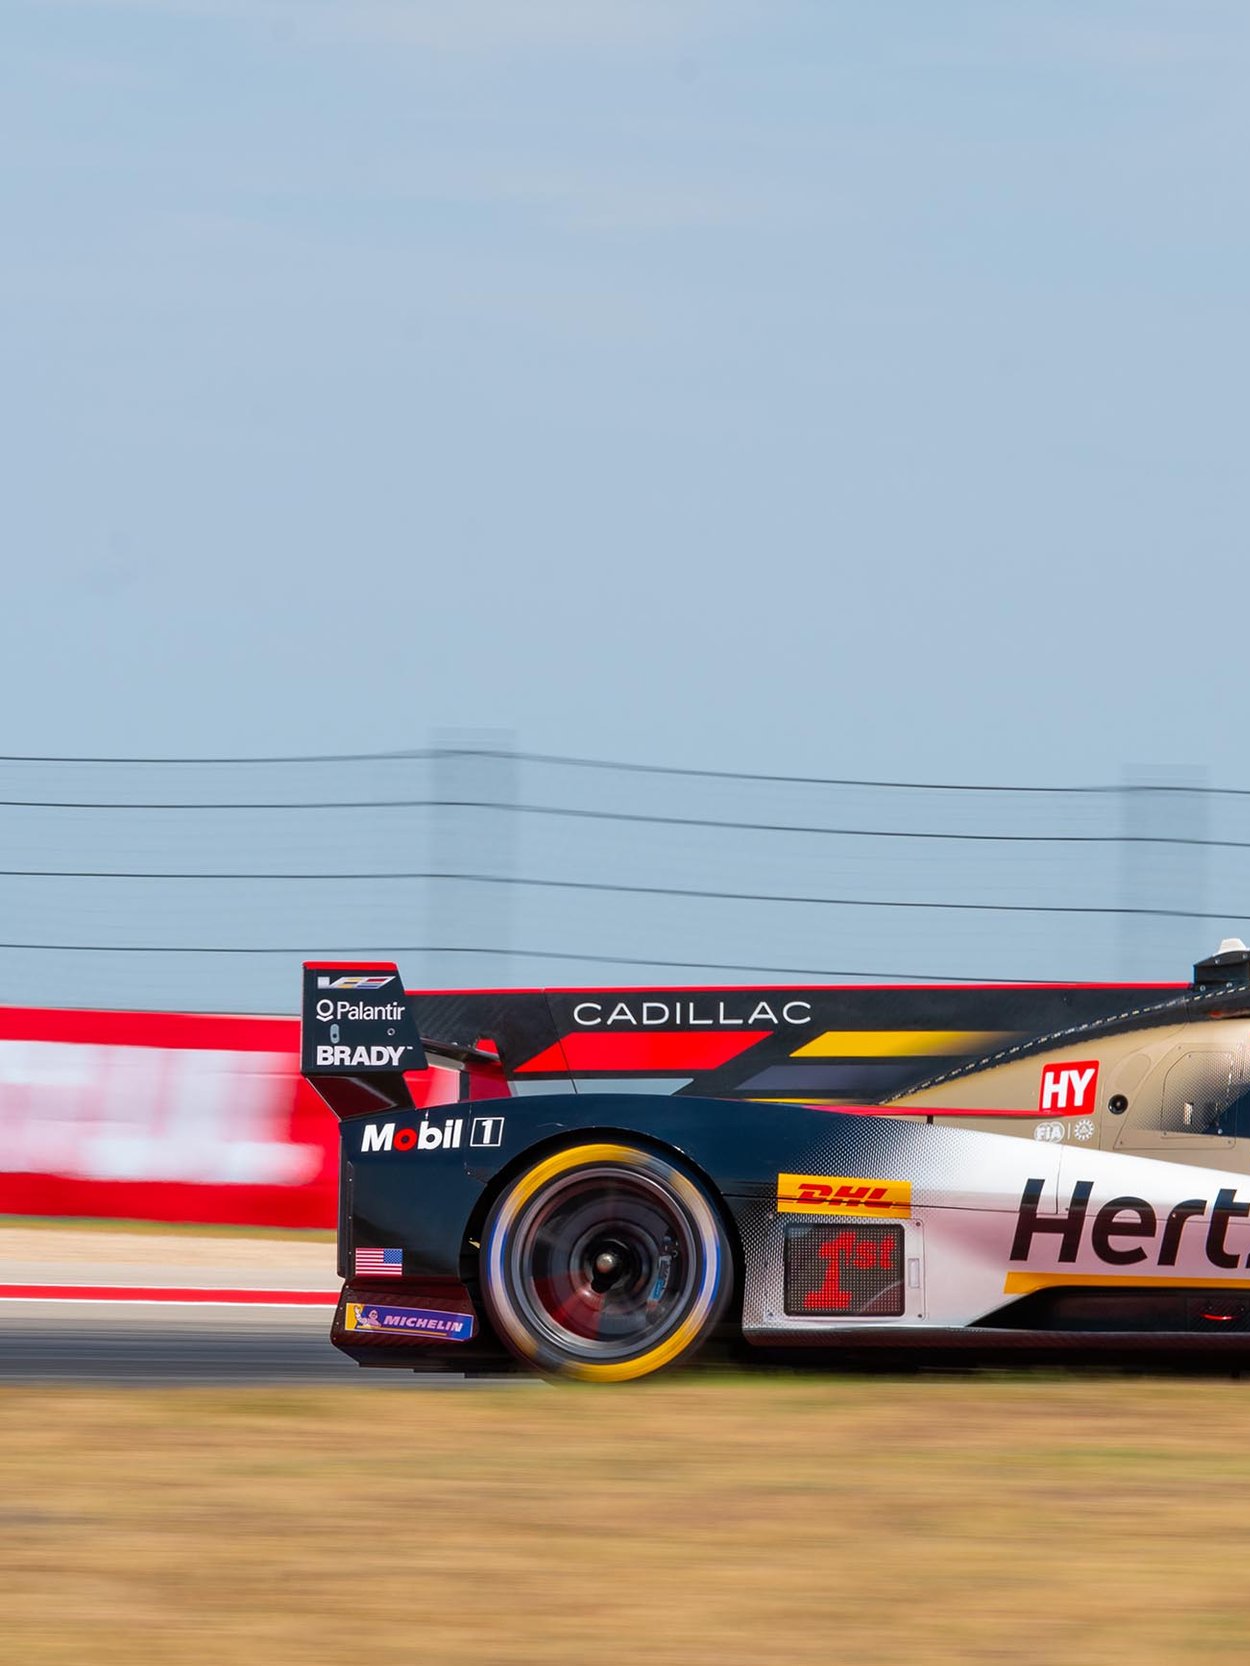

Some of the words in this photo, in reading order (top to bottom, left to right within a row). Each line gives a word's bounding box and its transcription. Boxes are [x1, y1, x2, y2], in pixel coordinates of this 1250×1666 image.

[337, 1001, 406, 1020] Palantir
[573, 1001, 811, 1025] CADILLAC
[1042, 1068, 1096, 1109] HY
[361, 1119, 464, 1152] Mobil
[1035, 1122, 1065, 1143] FIA
[796, 1183, 894, 1209] DHL
[383, 1315, 463, 1332] MICHELIN
